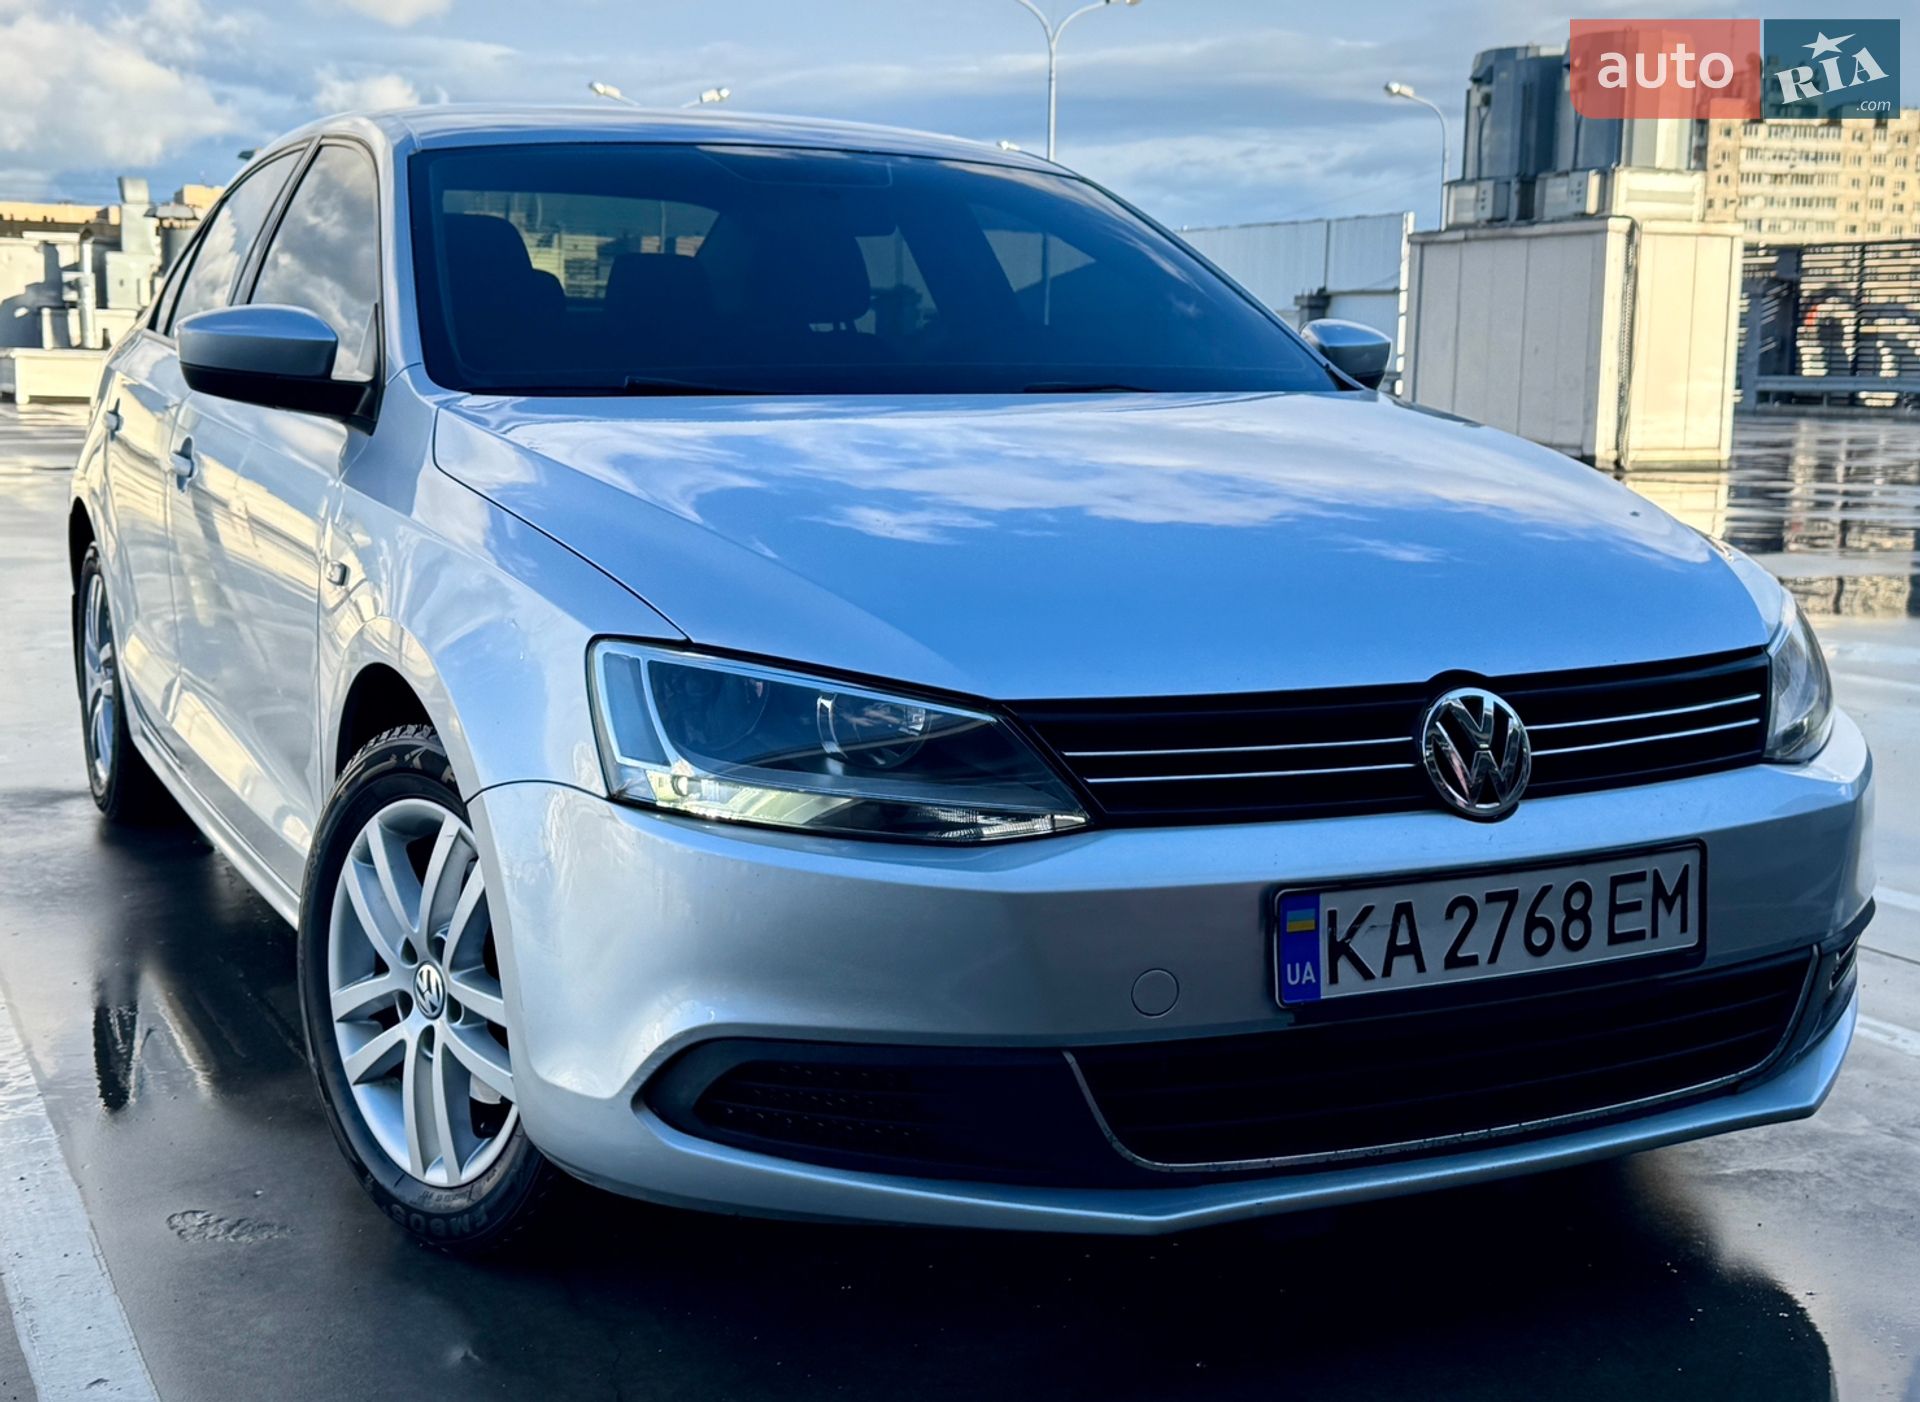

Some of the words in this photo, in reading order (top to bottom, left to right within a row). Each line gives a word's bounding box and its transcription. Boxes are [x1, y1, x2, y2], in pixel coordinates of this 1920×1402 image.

[1326, 901, 1426, 985] KA
[1444, 880, 1593, 970] 2768
[1607, 863, 1690, 946] EM
[1286, 961, 1316, 985] UA
